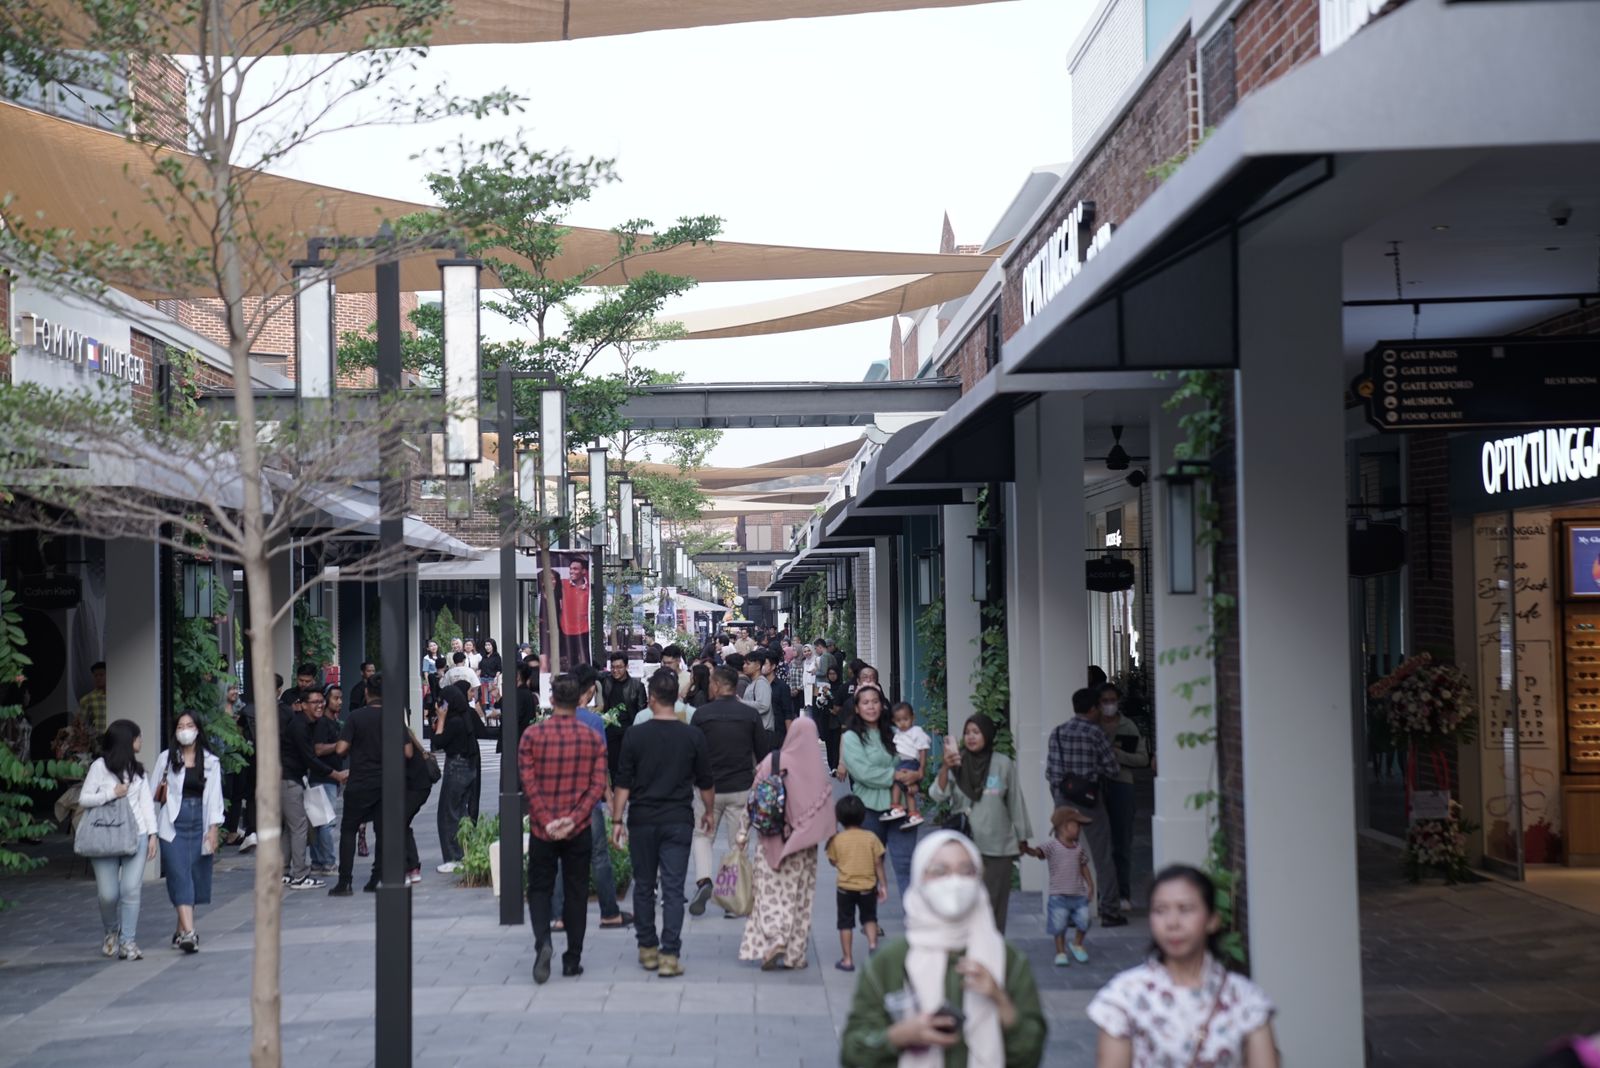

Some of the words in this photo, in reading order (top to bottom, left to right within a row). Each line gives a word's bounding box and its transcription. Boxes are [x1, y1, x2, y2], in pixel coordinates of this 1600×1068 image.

[29, 312, 84, 364] TOMMY
[102, 344, 145, 386] HILFIGER
[1400, 350, 1427, 360] GATE
[1429, 349, 1459, 360] PARIS
[1400, 366, 1427, 376] GATE
[1400, 381, 1428, 391] GATE
[1429, 380, 1475, 390] OXFORD
[1401, 412, 1430, 421] FOOD
[1430, 410, 1464, 420] COURT
